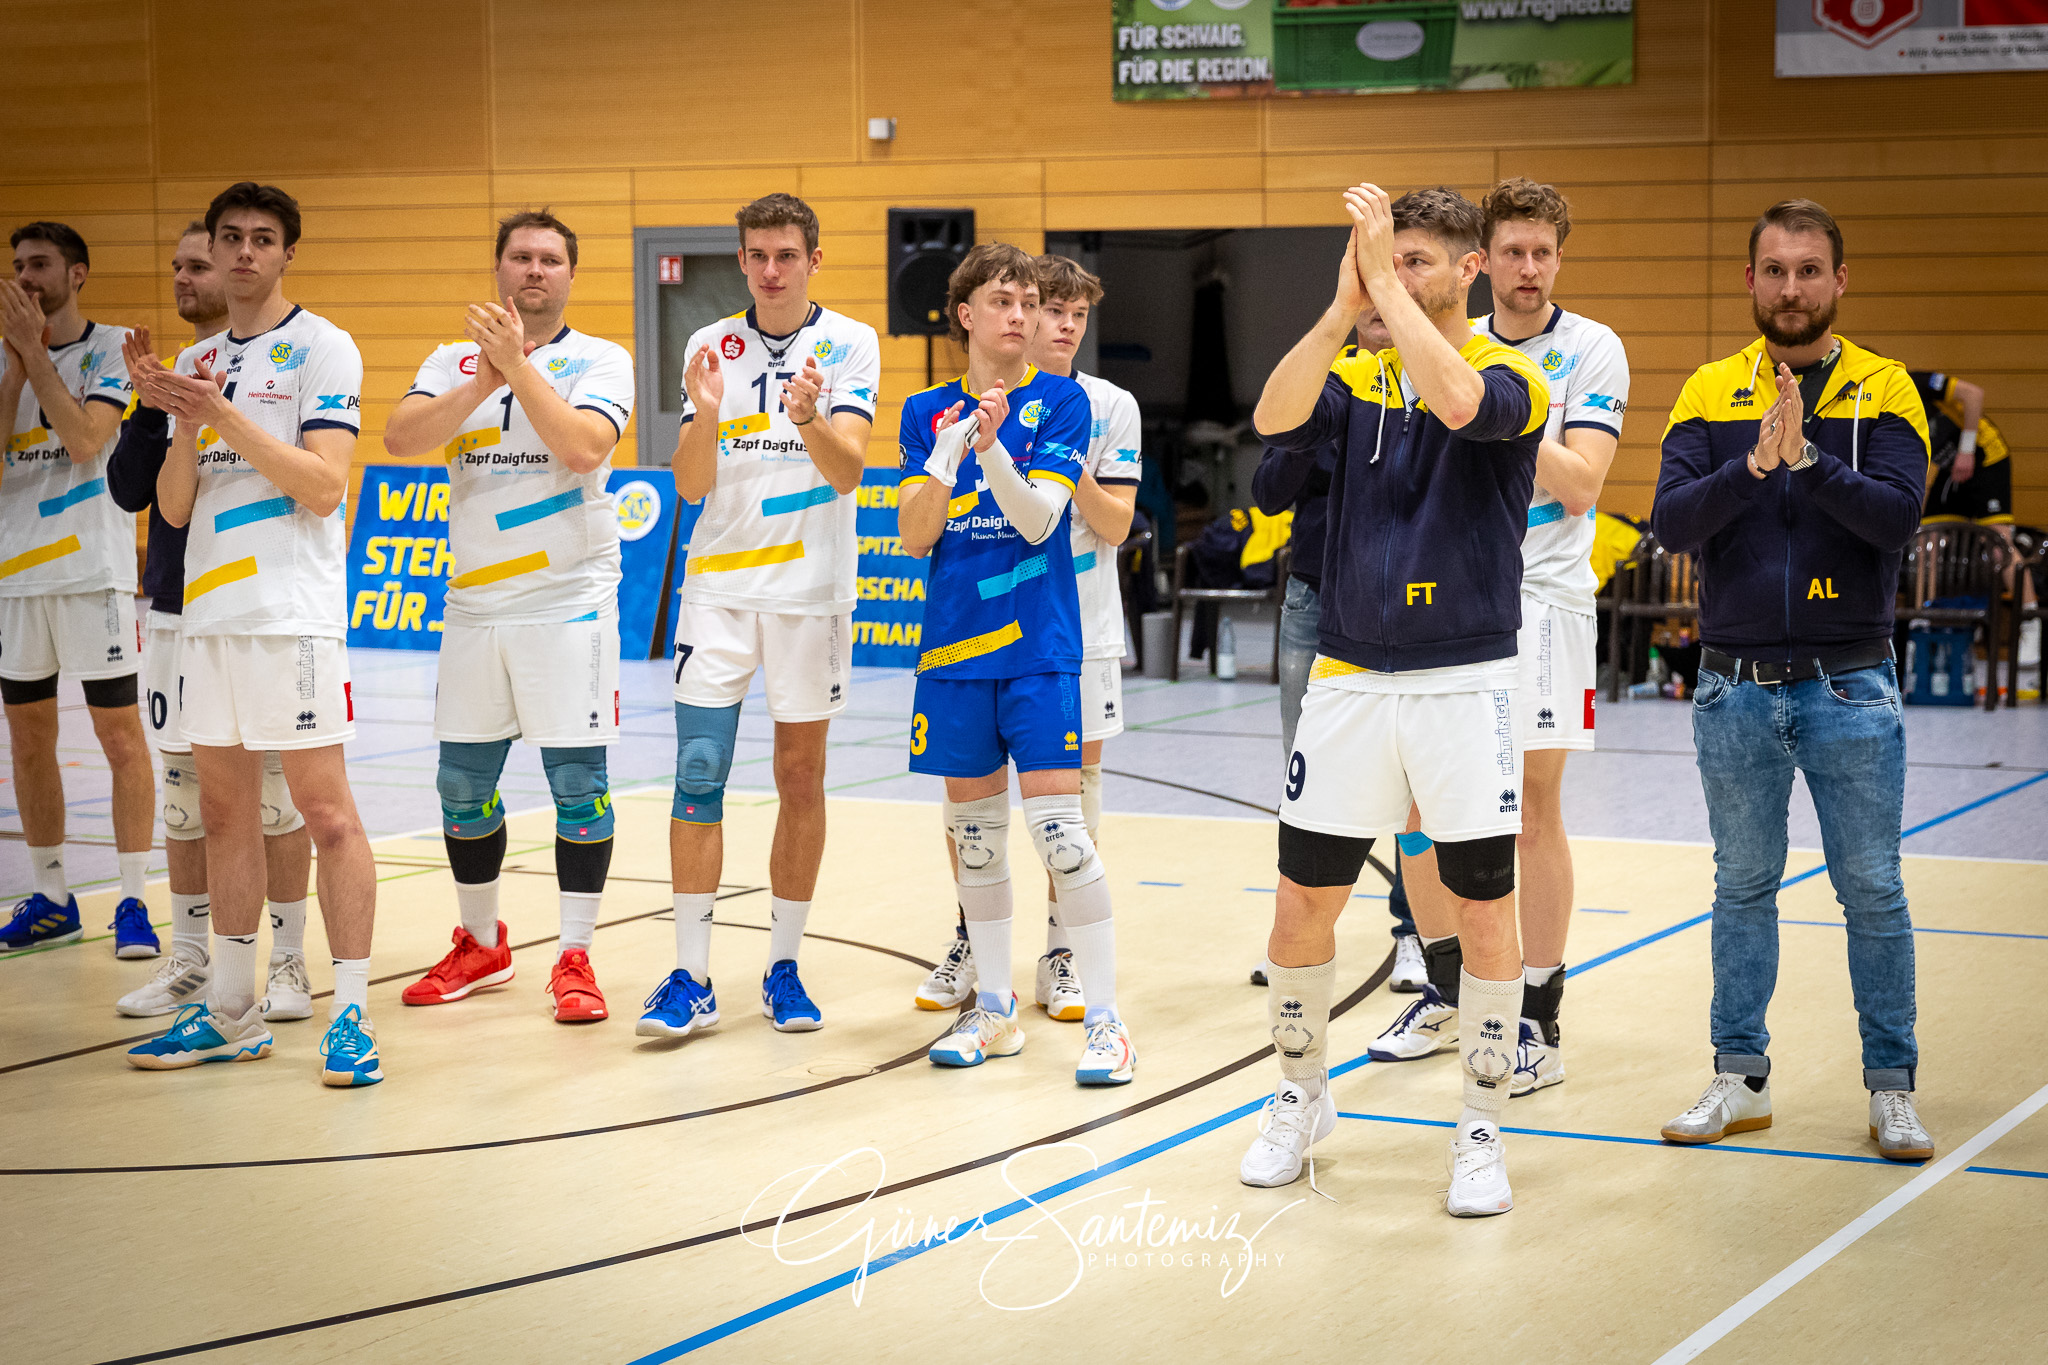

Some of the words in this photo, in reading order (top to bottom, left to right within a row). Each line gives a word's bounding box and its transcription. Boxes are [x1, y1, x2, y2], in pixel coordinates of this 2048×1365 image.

[1118, 21, 1158, 50] FÜR
[1118, 55, 1158, 84] FÜR
[1160, 58, 1194, 83] DIE
[1197, 56, 1272, 83] REGION.
[247, 391, 293, 401] Heinzelmann
[500, 391, 514, 432] 1
[732, 438, 760, 452] Zapf
[465, 452, 490, 466] Zapf
[492, 452, 549, 467] Daigfuss
[378, 482, 450, 522] WIR
[945, 516, 971, 534] Zapf
[1406, 582, 1437, 606] FT
[1807, 577, 1839, 600] AL
[910, 712, 929, 756] 3
[1285, 750, 1307, 802] 9
